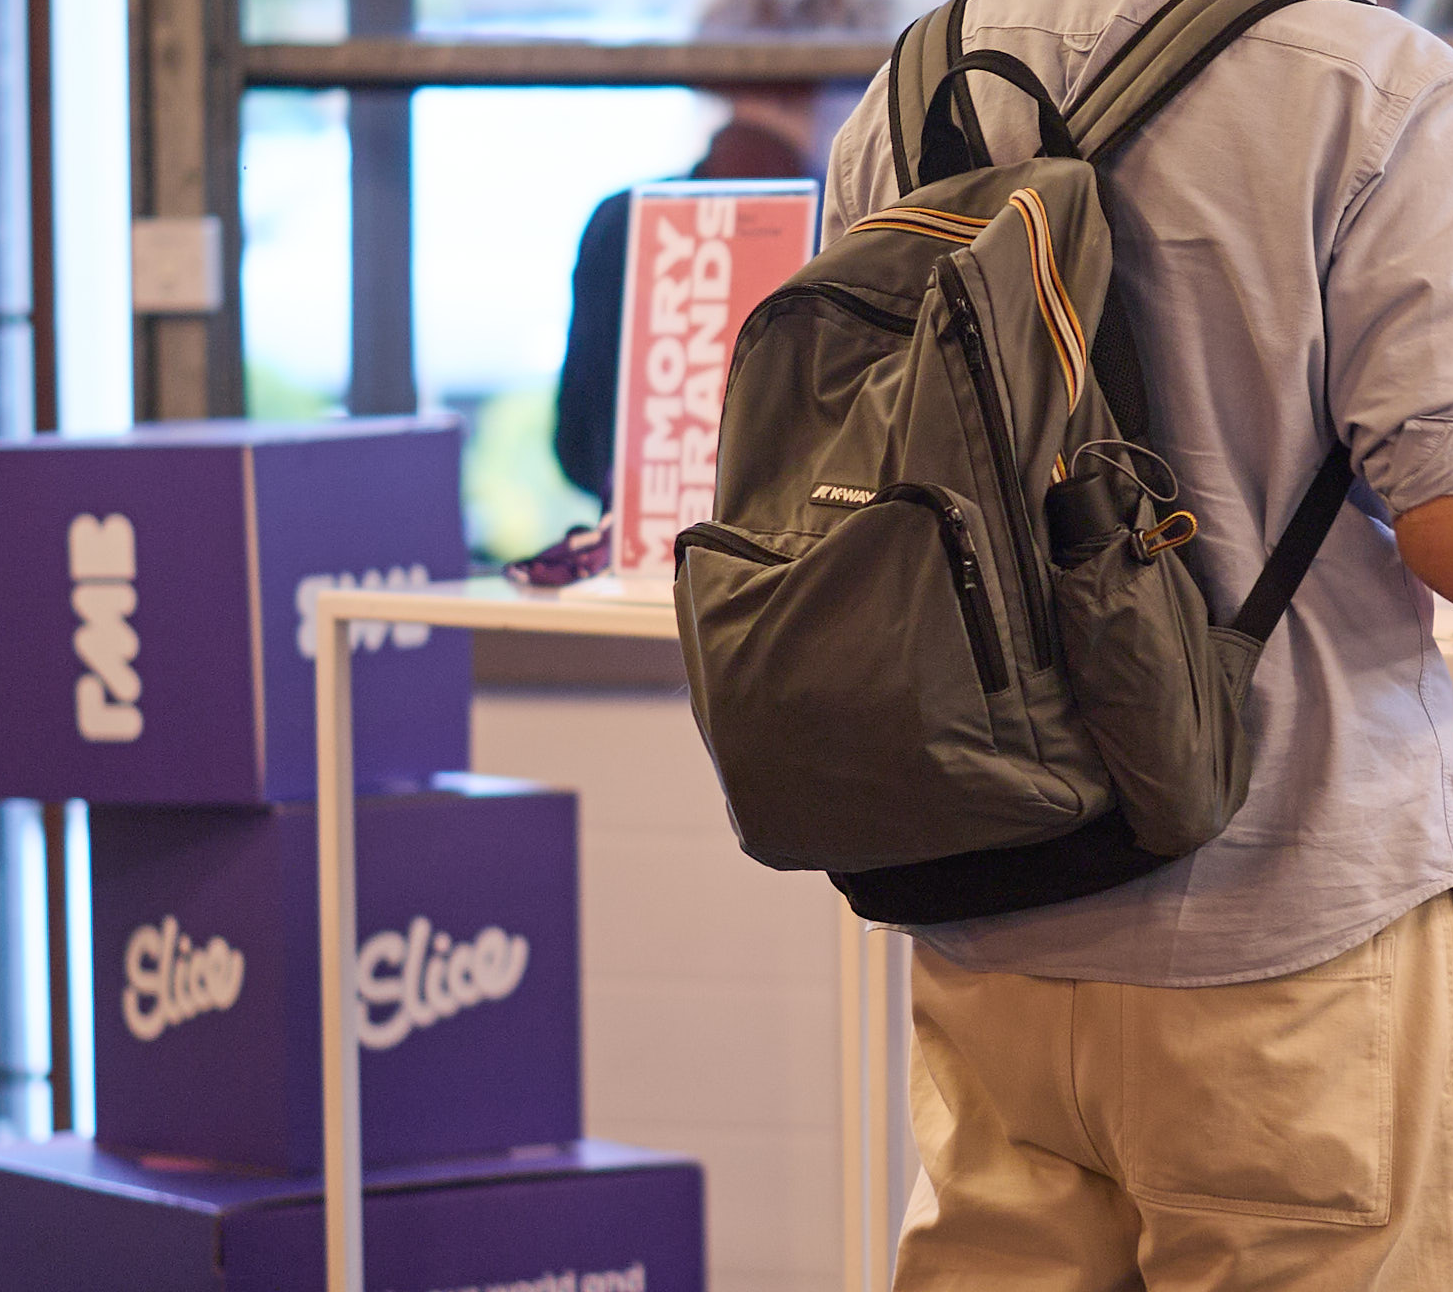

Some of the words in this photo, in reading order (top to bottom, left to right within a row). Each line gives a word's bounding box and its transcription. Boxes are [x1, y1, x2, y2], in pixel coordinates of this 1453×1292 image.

[638, 215, 695, 576] MEMORY
[122, 915, 245, 1042] Slice
[358, 916, 530, 1050] Slice
